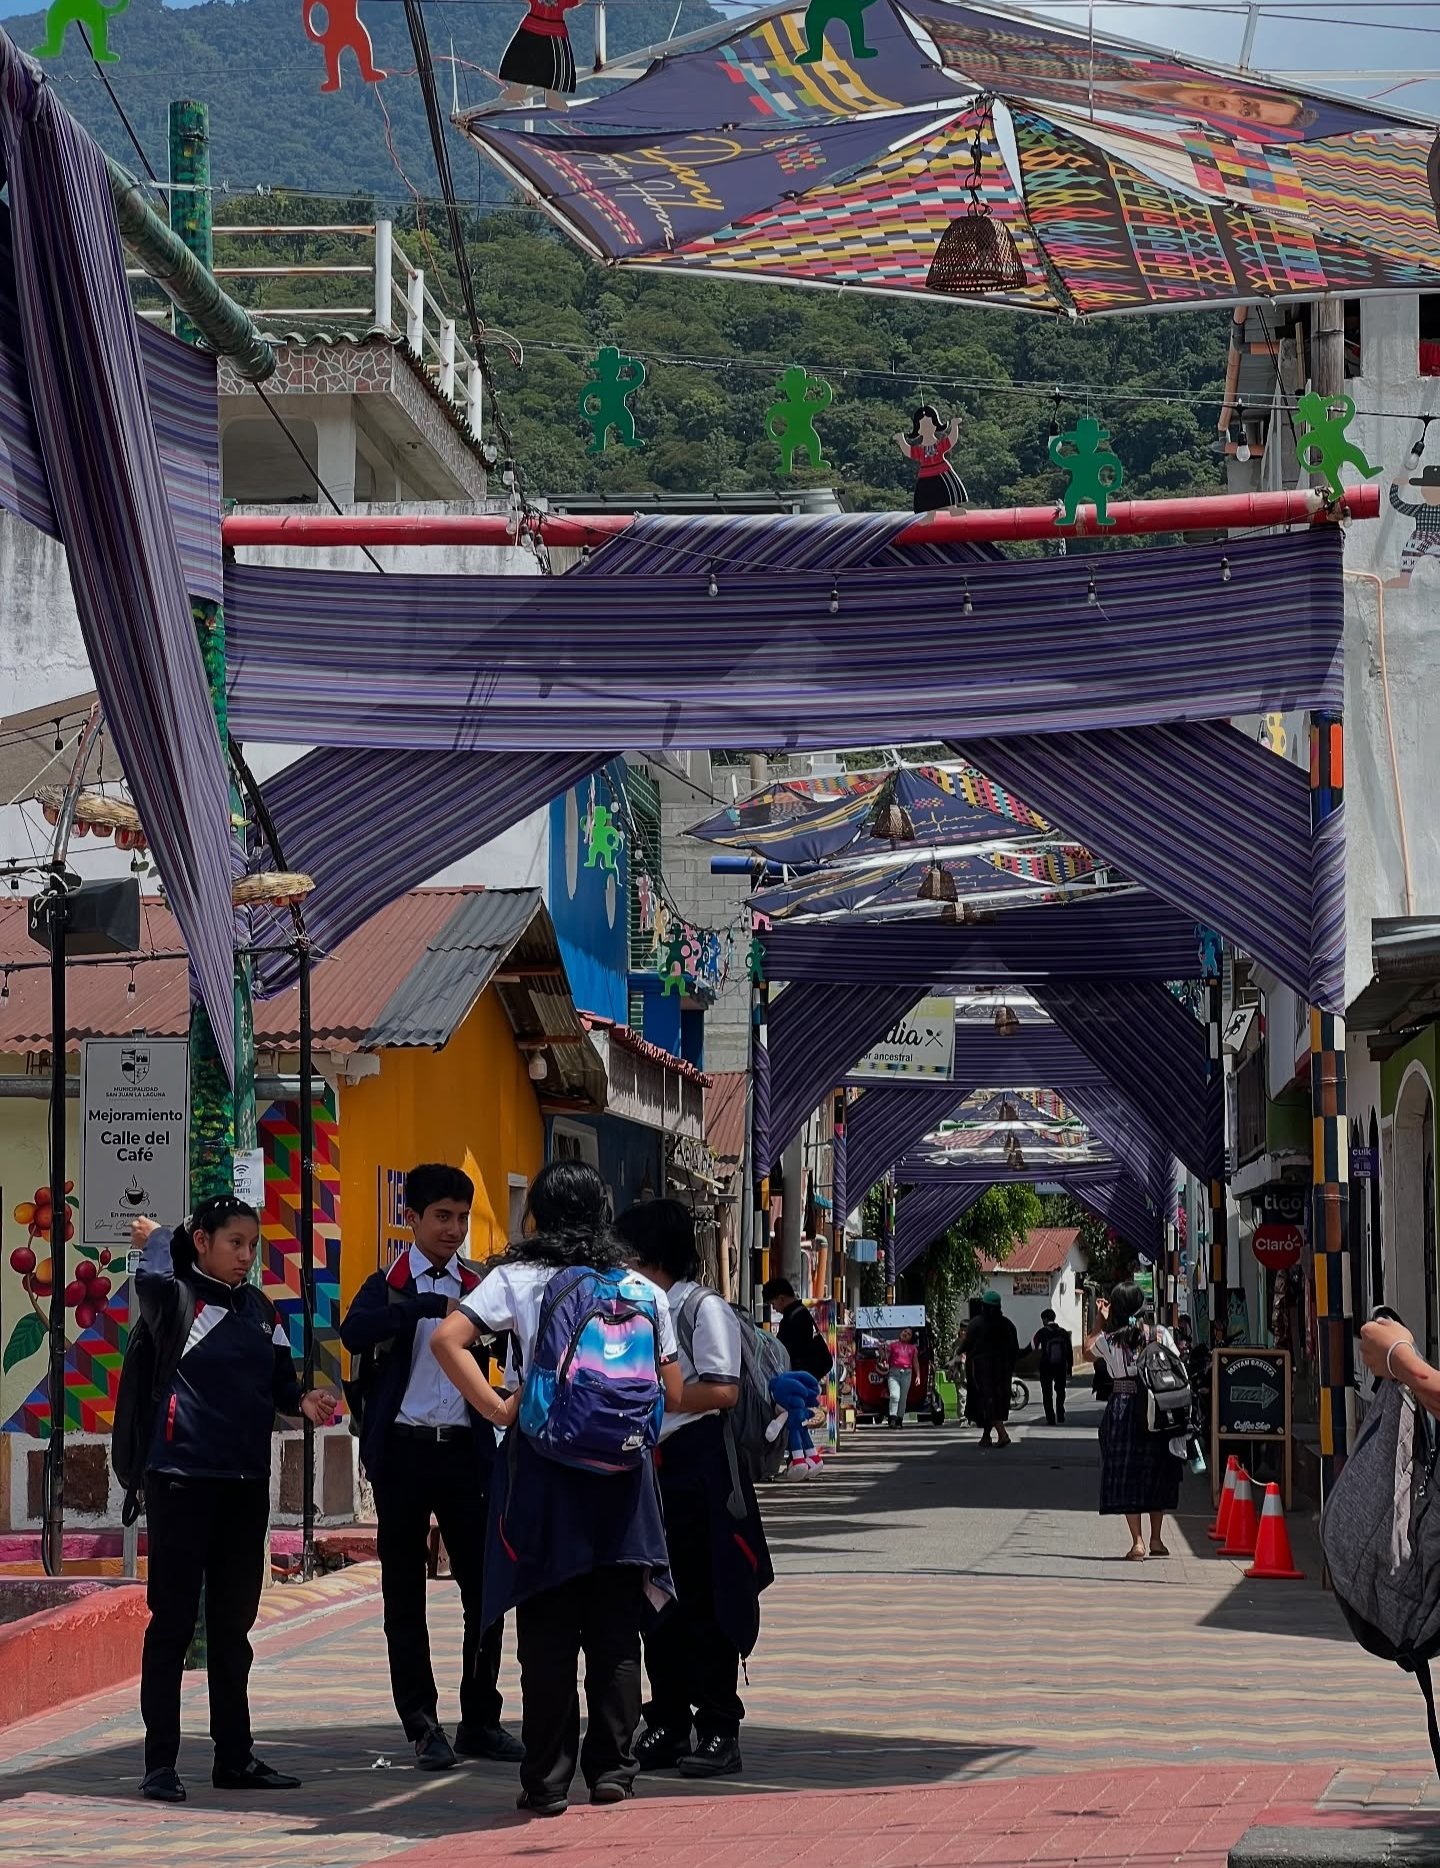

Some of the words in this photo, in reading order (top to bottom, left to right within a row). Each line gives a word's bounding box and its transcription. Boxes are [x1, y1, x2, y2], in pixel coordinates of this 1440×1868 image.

[615, 180, 686, 250] Herrera
[874, 1053, 913, 1062] ancestral
[88, 1108, 183, 1123] Mejoramiento
[100, 1131, 141, 1145] Calle
[144, 1131, 170, 1145] del
[116, 1146, 154, 1162] Café
[1264, 1194, 1302, 1217] tigo
[1255, 1238, 1294, 1250] Claro
[1233, 1420, 1255, 1432] Coffee
[1255, 1421, 1271, 1431] Shop
